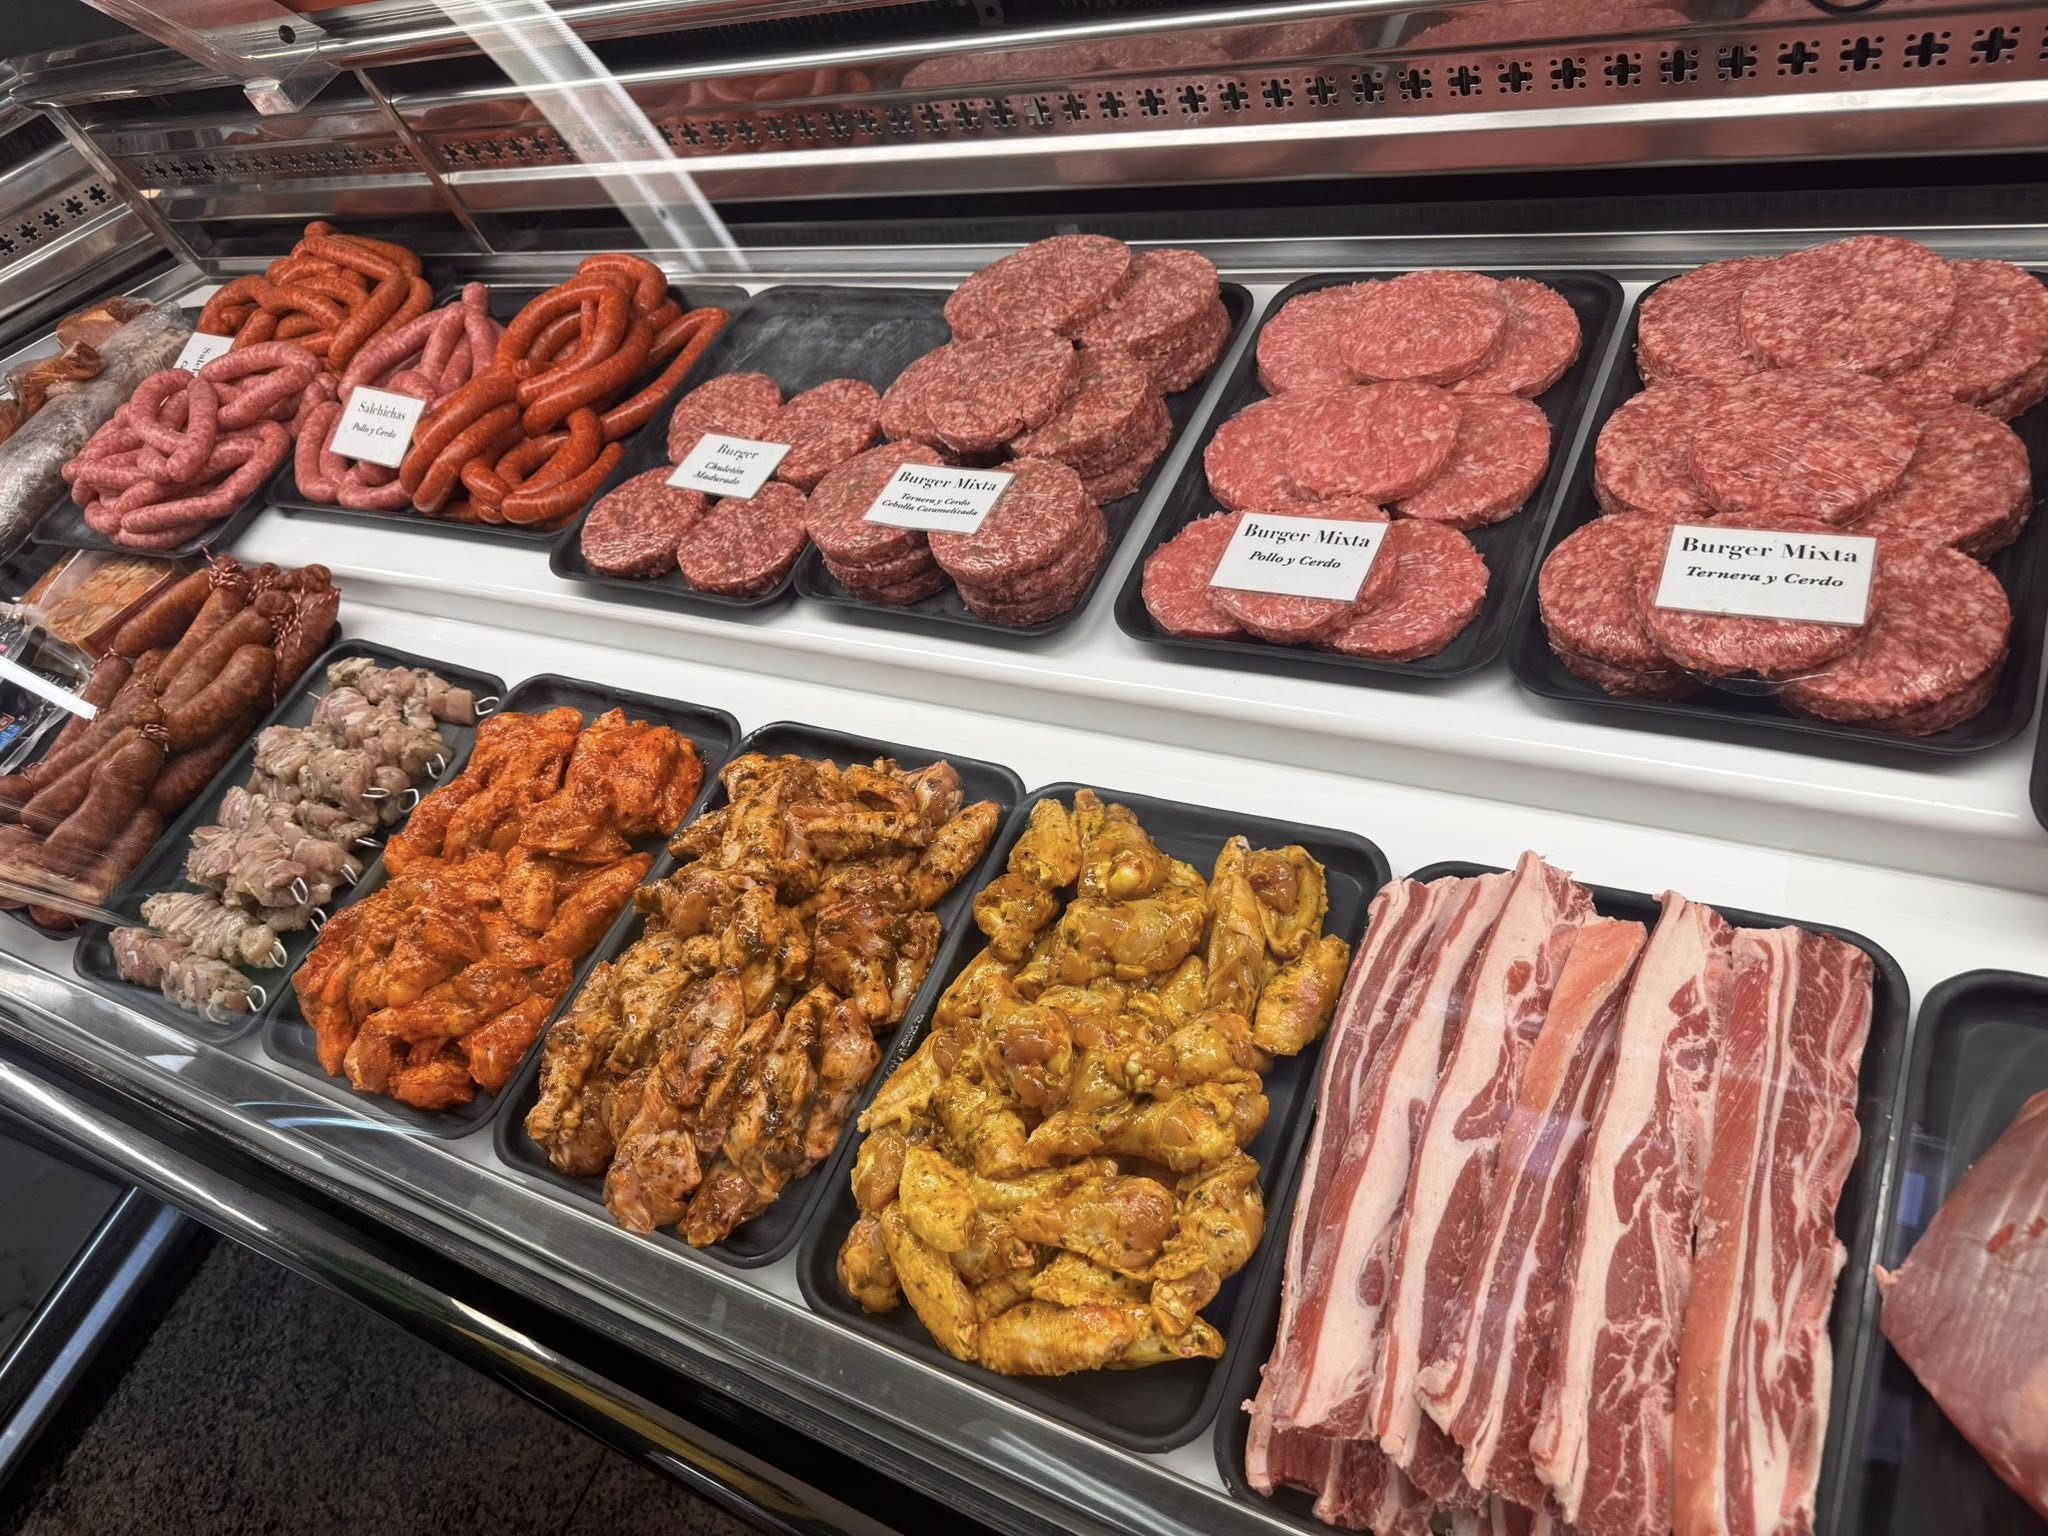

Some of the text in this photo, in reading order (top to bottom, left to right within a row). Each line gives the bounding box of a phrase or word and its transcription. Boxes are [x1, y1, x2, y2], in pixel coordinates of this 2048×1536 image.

[192, 347, 211, 374] Salch
[358, 400, 406, 421] Salchichas
[352, 422, 397, 439] Pollo y Cerdo
[716, 443, 759, 461] Burger
[704, 461, 745, 475] Chuletón
[692, 470, 740, 485] Madurado
[898, 471, 997, 491] Burger Mixta
[881, 499, 978, 516] Cebolla Caramelizada
[901, 493, 935, 504] Ternera
[944, 498, 971, 506] Cerdo
[1244, 523, 1370, 548] Burger Mixta
[1682, 536, 1858, 563] Burger Mixta
[1248, 551, 1341, 569] Pollo y Cerdo
[1686, 565, 1844, 588] Ternera y Cerdo
